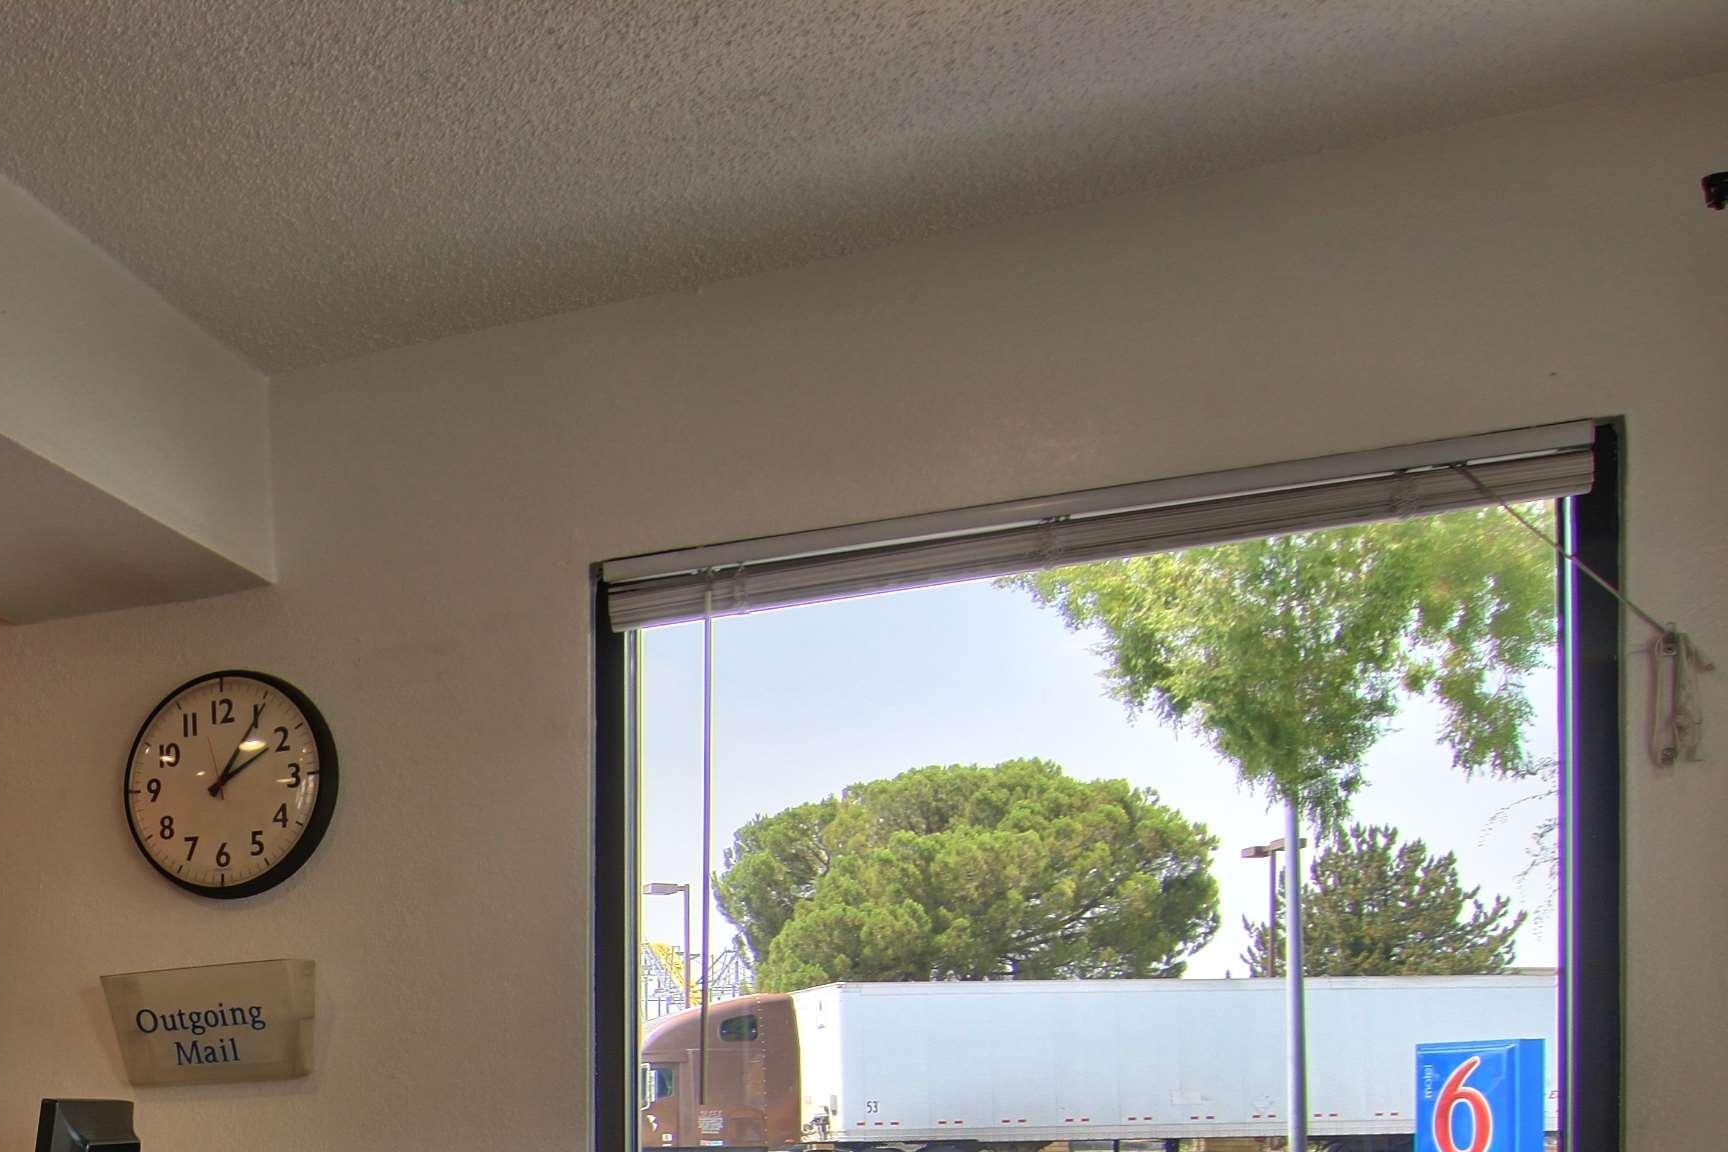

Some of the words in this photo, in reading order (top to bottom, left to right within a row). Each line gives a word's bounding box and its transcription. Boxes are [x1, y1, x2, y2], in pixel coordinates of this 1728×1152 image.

[211, 698, 235, 726] 12
[182, 713, 198, 738] 11
[274, 727, 291, 753] 2
[159, 742, 181, 769] 10
[286, 763, 302, 788] 3
[146, 778, 162, 803] 9
[159, 815, 175, 841] 8
[273, 803, 289, 829] 4
[184, 836, 199, 862] 7
[215, 841, 231, 868] 6
[250, 831, 265, 857] 5
[135, 1003, 267, 1038] Outgoing
[174, 1037, 241, 1066] Mail
[1423, 1064, 1434, 1099] motel
[866, 1100, 879, 1115] 53
